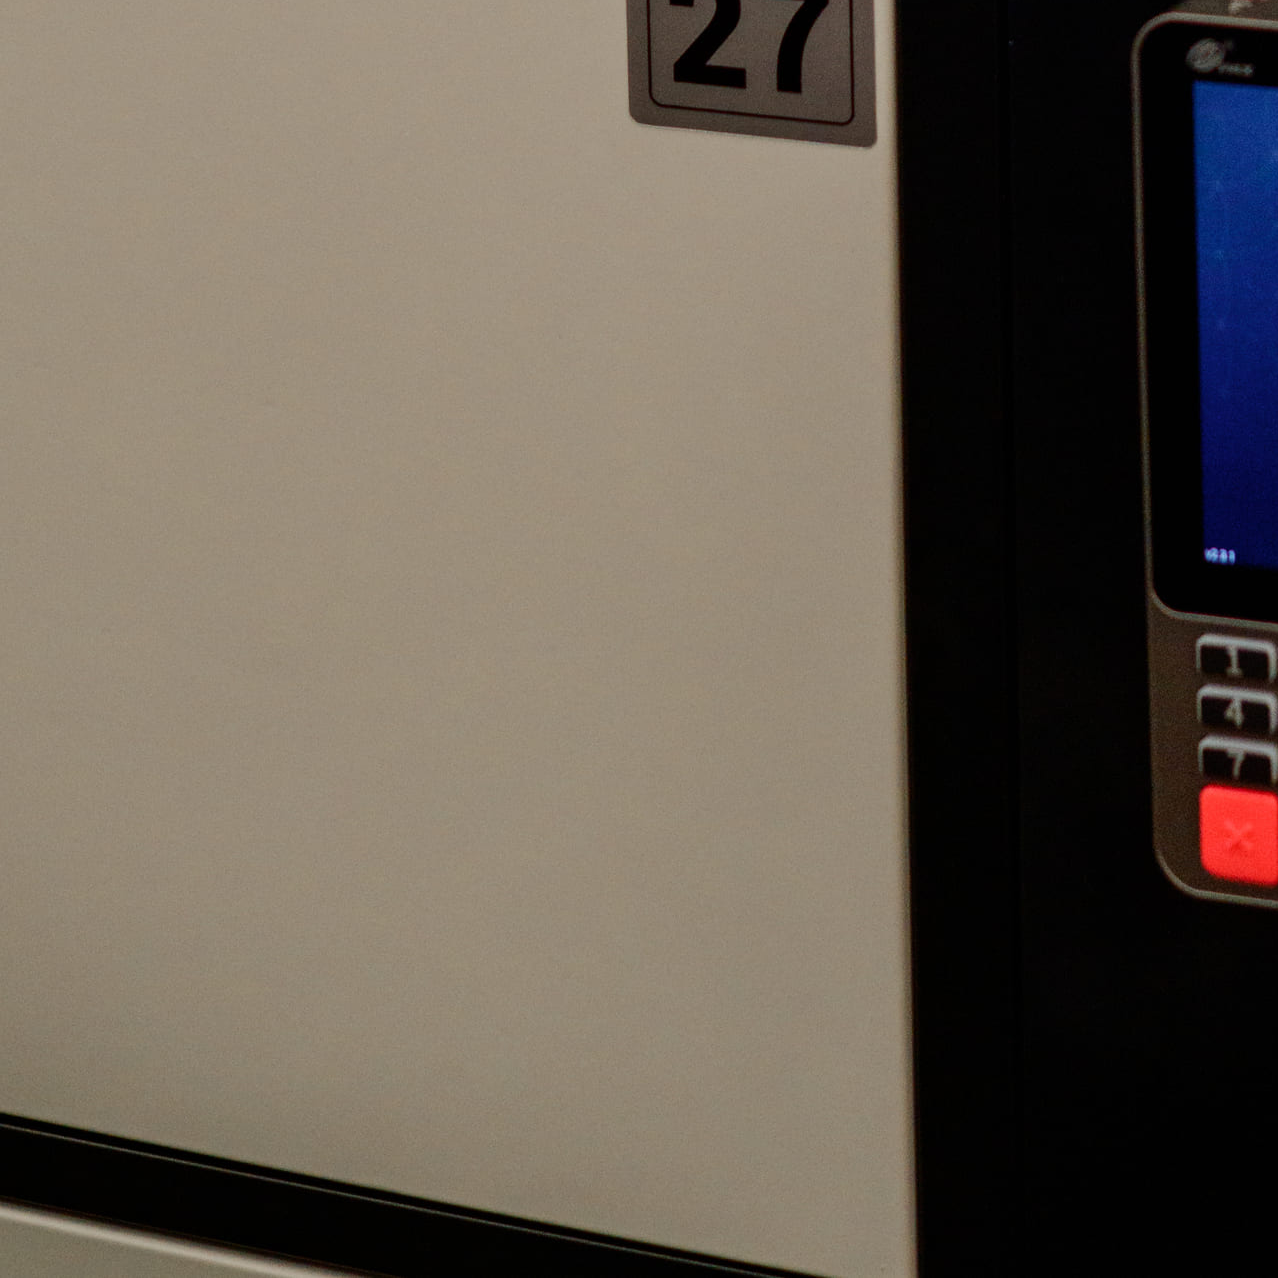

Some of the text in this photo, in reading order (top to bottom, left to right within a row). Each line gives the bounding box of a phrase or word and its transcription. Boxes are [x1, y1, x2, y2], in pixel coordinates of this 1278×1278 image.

[1228, 646, 1243, 675] 1
[1225, 698, 1245, 729] 4
[1227, 751, 1246, 780] 7
